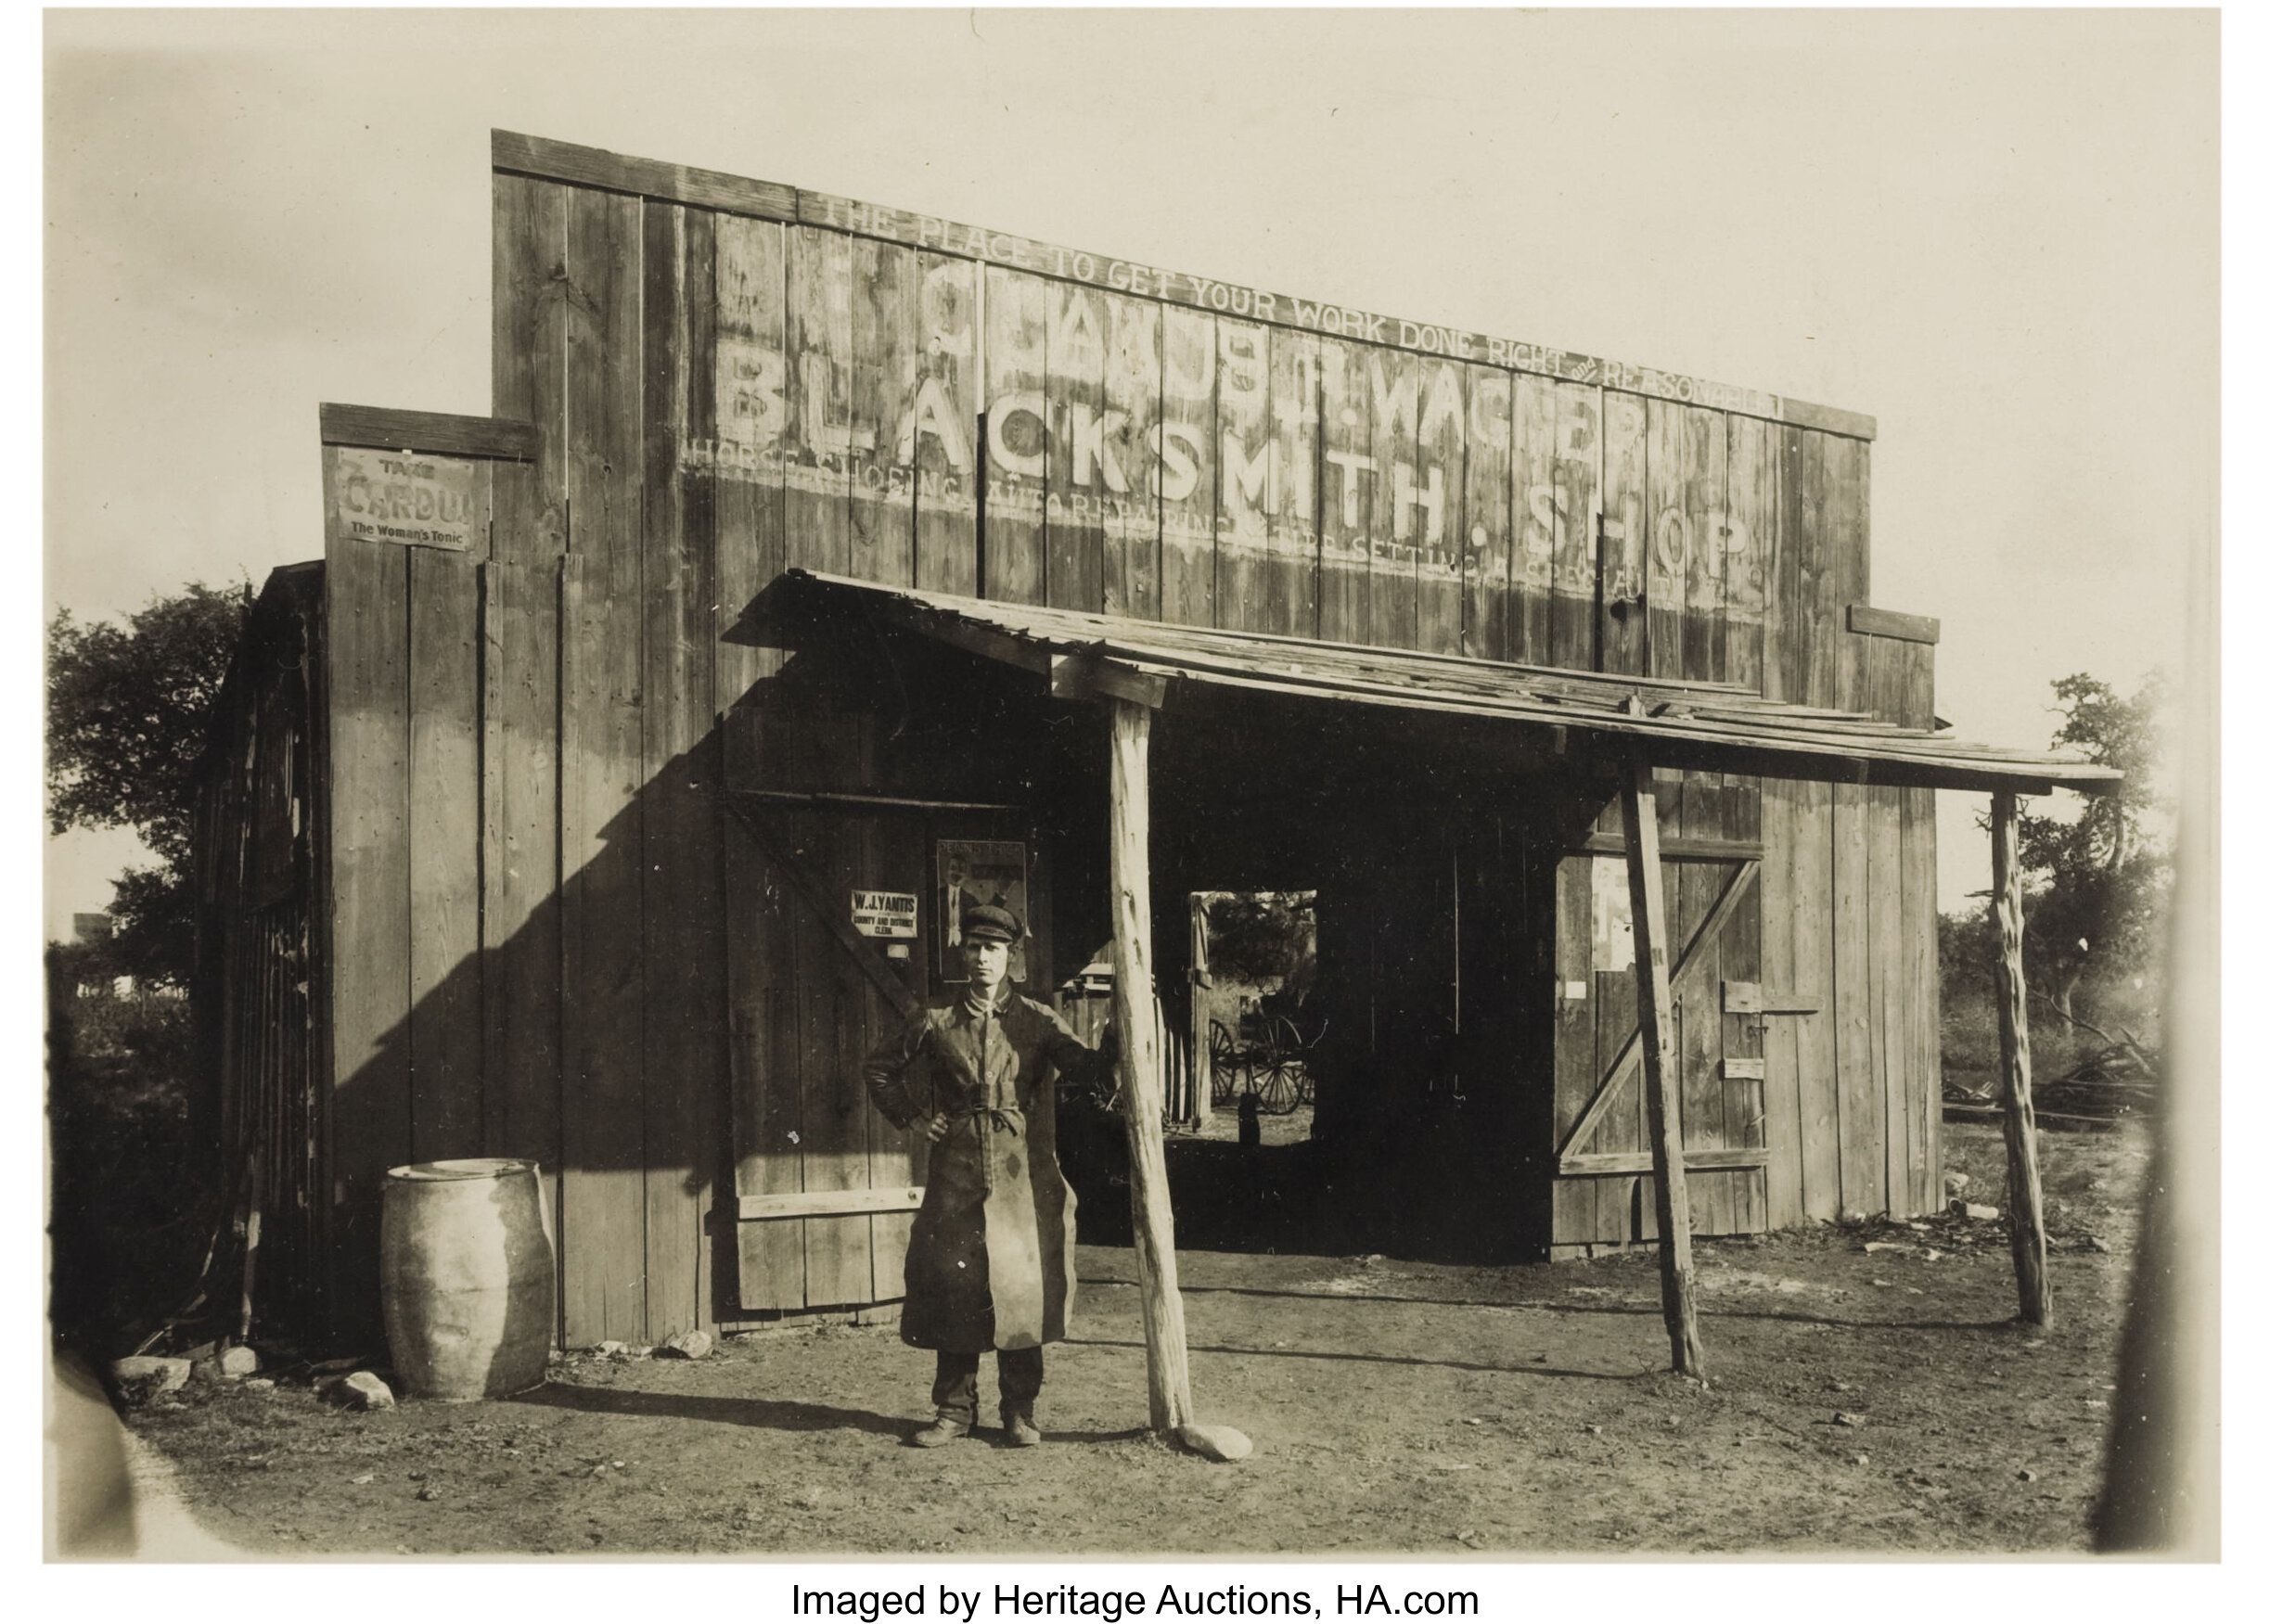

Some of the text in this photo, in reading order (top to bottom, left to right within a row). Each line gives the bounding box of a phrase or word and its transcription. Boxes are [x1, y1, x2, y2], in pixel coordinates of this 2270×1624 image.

[817, 193, 897, 239] THE
[917, 215, 1031, 267] PLACE
[1051, 248, 1094, 280] TO
[1109, 262, 1174, 299] GET
[1187, 277, 1276, 321] YOUR
[1290, 299, 1387, 343] WORK
[1399, 320, 1474, 358] DONE
[1486, 336, 1566, 377] RIGHT
[1571, 356, 1597, 381] and
[378, 459, 435, 480] TAKE
[352, 521, 464, 544] The Woman's Tonic
[1528, 484, 1748, 580] SHOP
[854, 915, 914, 927] COUNTY AND DISTRICT
[875, 926, 893, 935] CLERK
